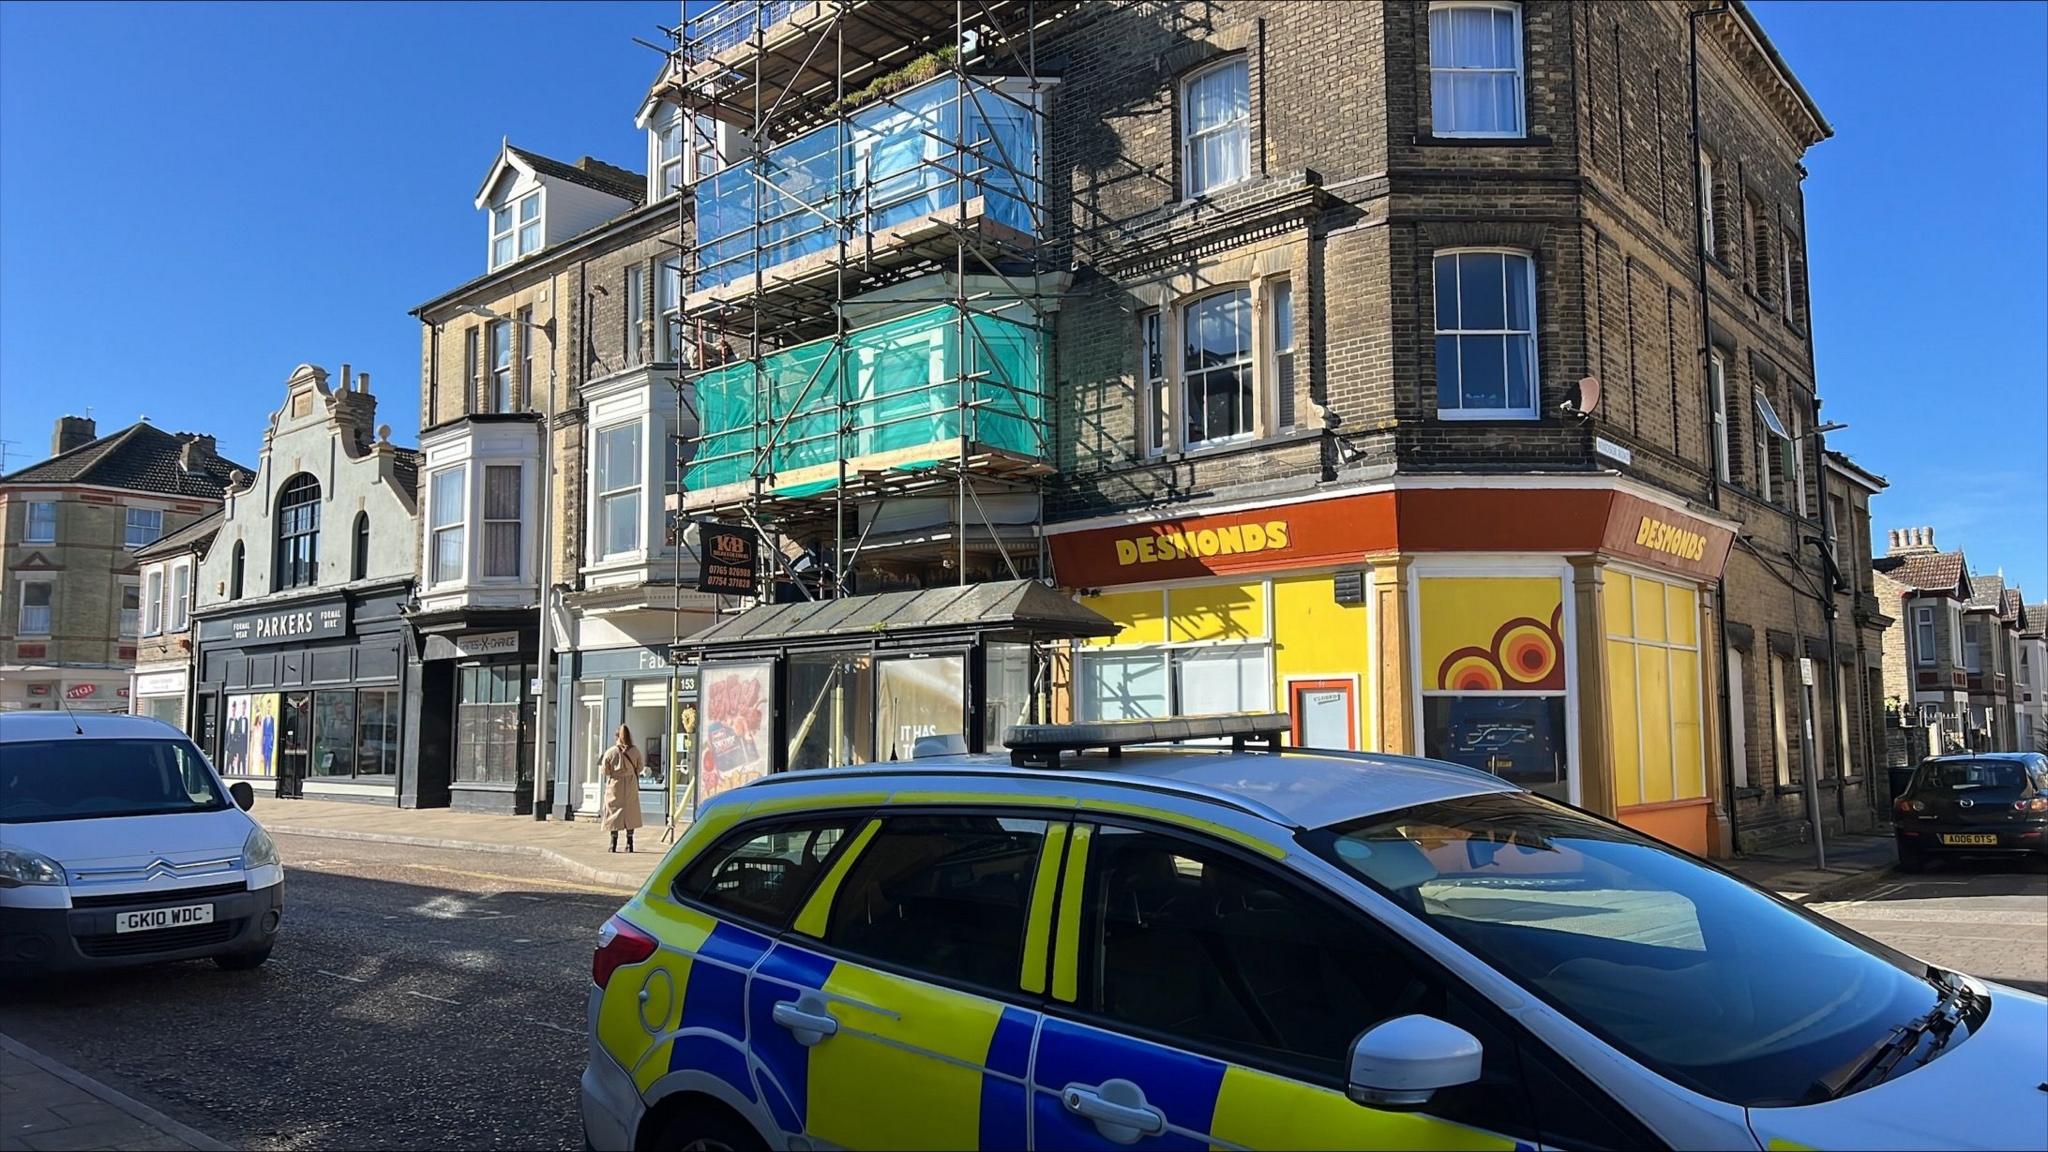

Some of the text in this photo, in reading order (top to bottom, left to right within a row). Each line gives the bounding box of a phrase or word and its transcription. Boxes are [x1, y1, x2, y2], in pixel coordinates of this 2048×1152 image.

[1115, 521, 1287, 565] DESMONDS
[1636, 516, 1707, 561] DESMONDS
[709, 565, 727, 575] 07765
[707, 576, 728, 586] 07754
[256, 611, 313, 638] PARKERS
[681, 678, 695, 690] 153
[901, 724, 937, 741] IT HAS
[128, 907, 203, 928] GK10 WDC
